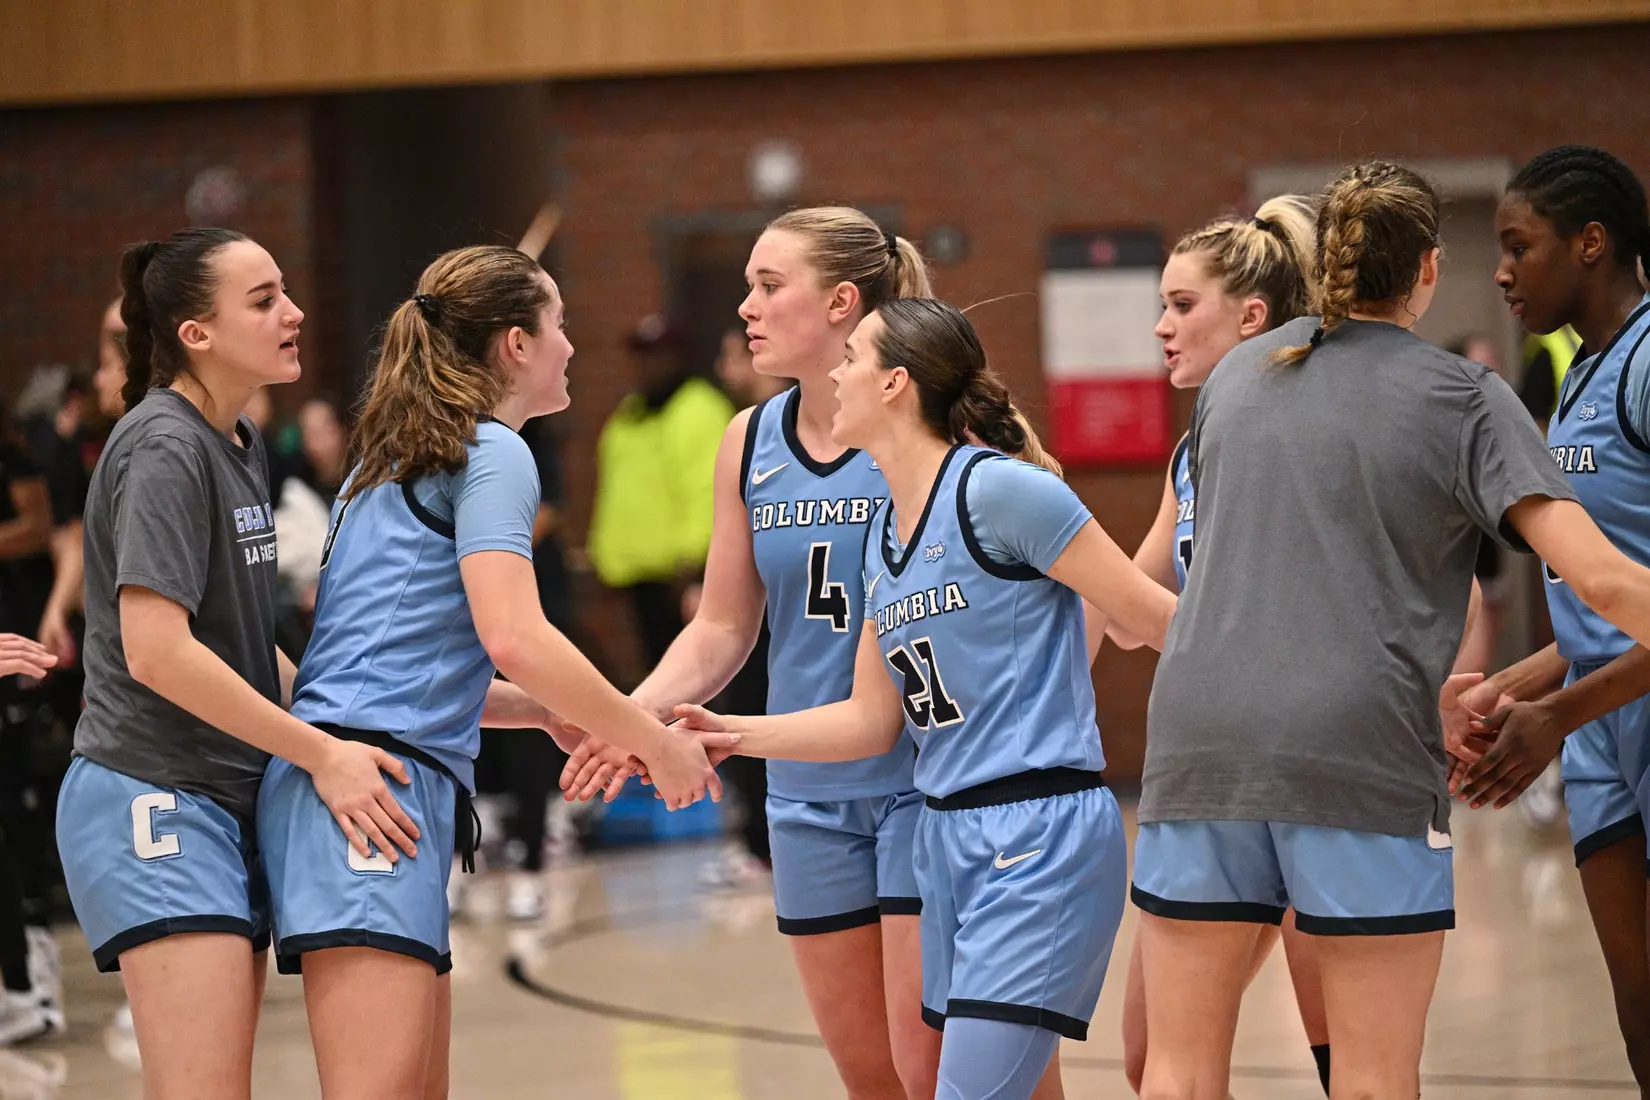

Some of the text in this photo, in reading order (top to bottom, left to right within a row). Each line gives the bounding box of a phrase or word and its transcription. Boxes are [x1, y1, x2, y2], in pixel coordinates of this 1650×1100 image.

[805, 541, 851, 633] 4
[874, 582, 969, 639] LUMBIA
[886, 636, 965, 730] 21
[130, 792, 182, 861] C
